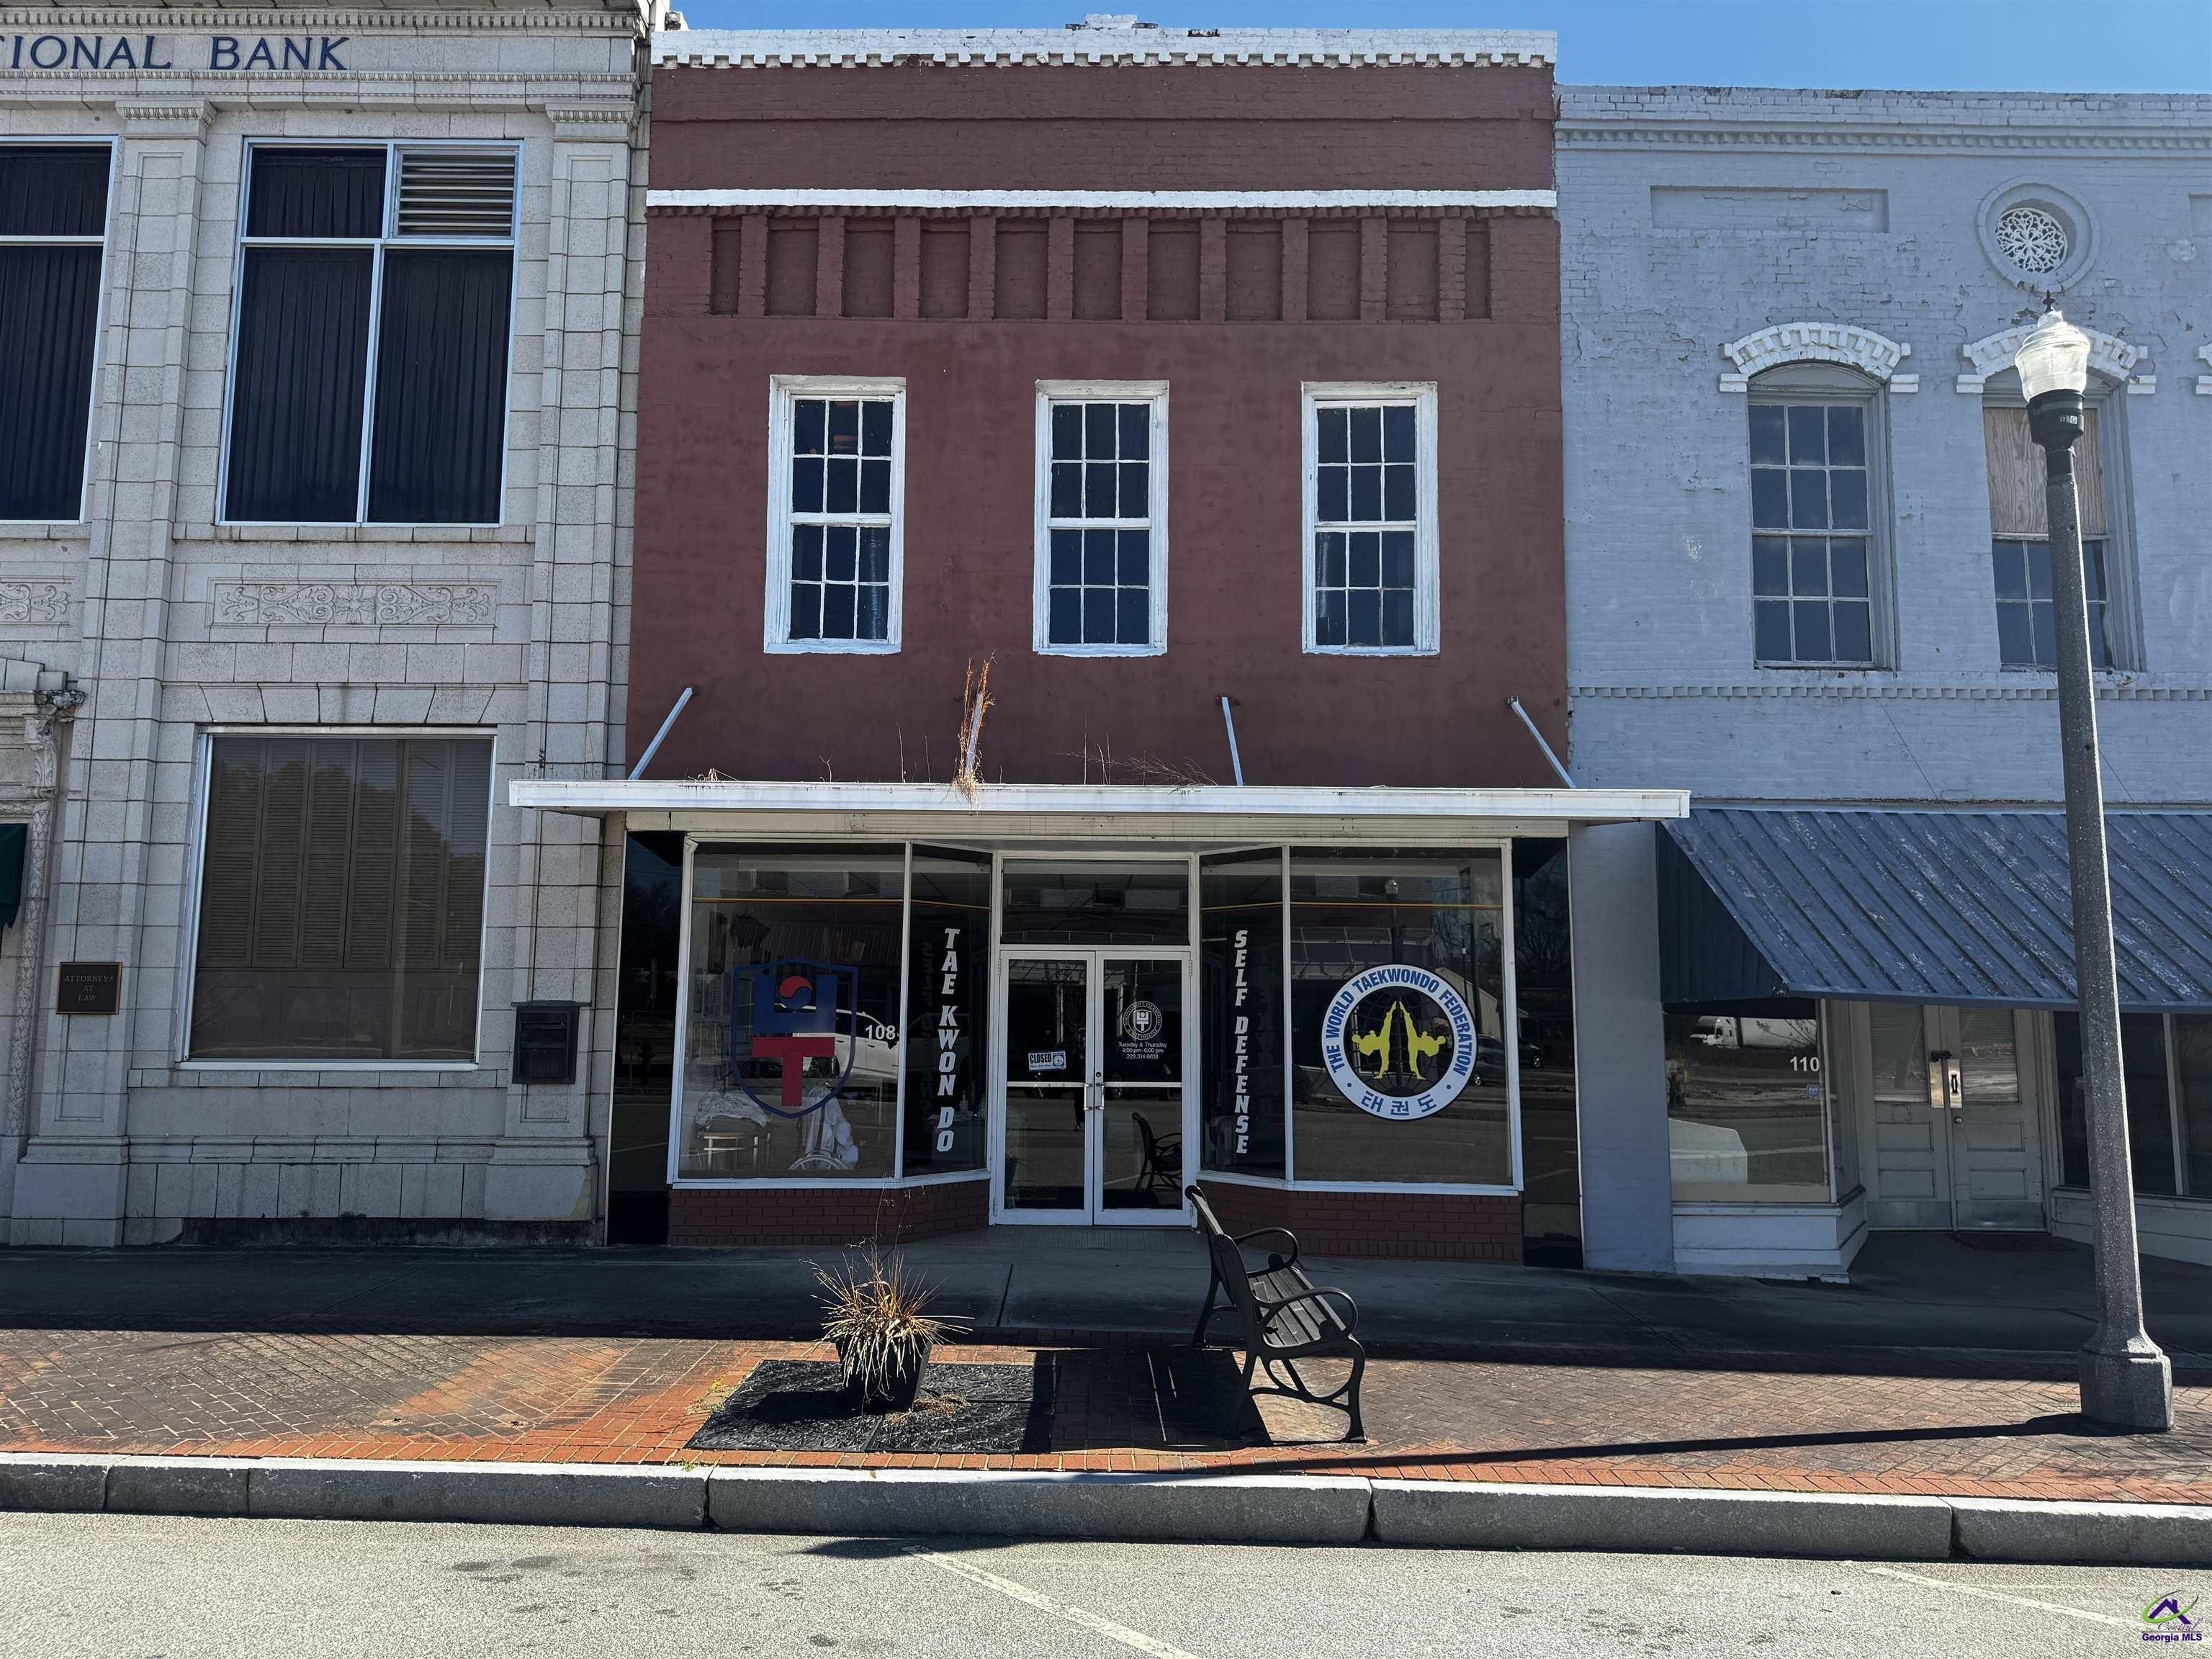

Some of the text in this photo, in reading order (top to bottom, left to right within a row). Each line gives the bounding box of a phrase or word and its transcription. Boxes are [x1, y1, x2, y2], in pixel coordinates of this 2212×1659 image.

[0, 35, 350, 71] IONAL BANK
[866, 1025, 896, 1040] 108
[936, 927, 960, 1152] TAE KWON DO
[1326, 968, 1473, 1076] THE WORLD TAEKWONDO FEDERATION
[1030, 1053, 1052, 1064] CLOSED
[1234, 930, 1250, 1154] SELF DEFENSE
[1789, 1056, 1820, 1071] 110
